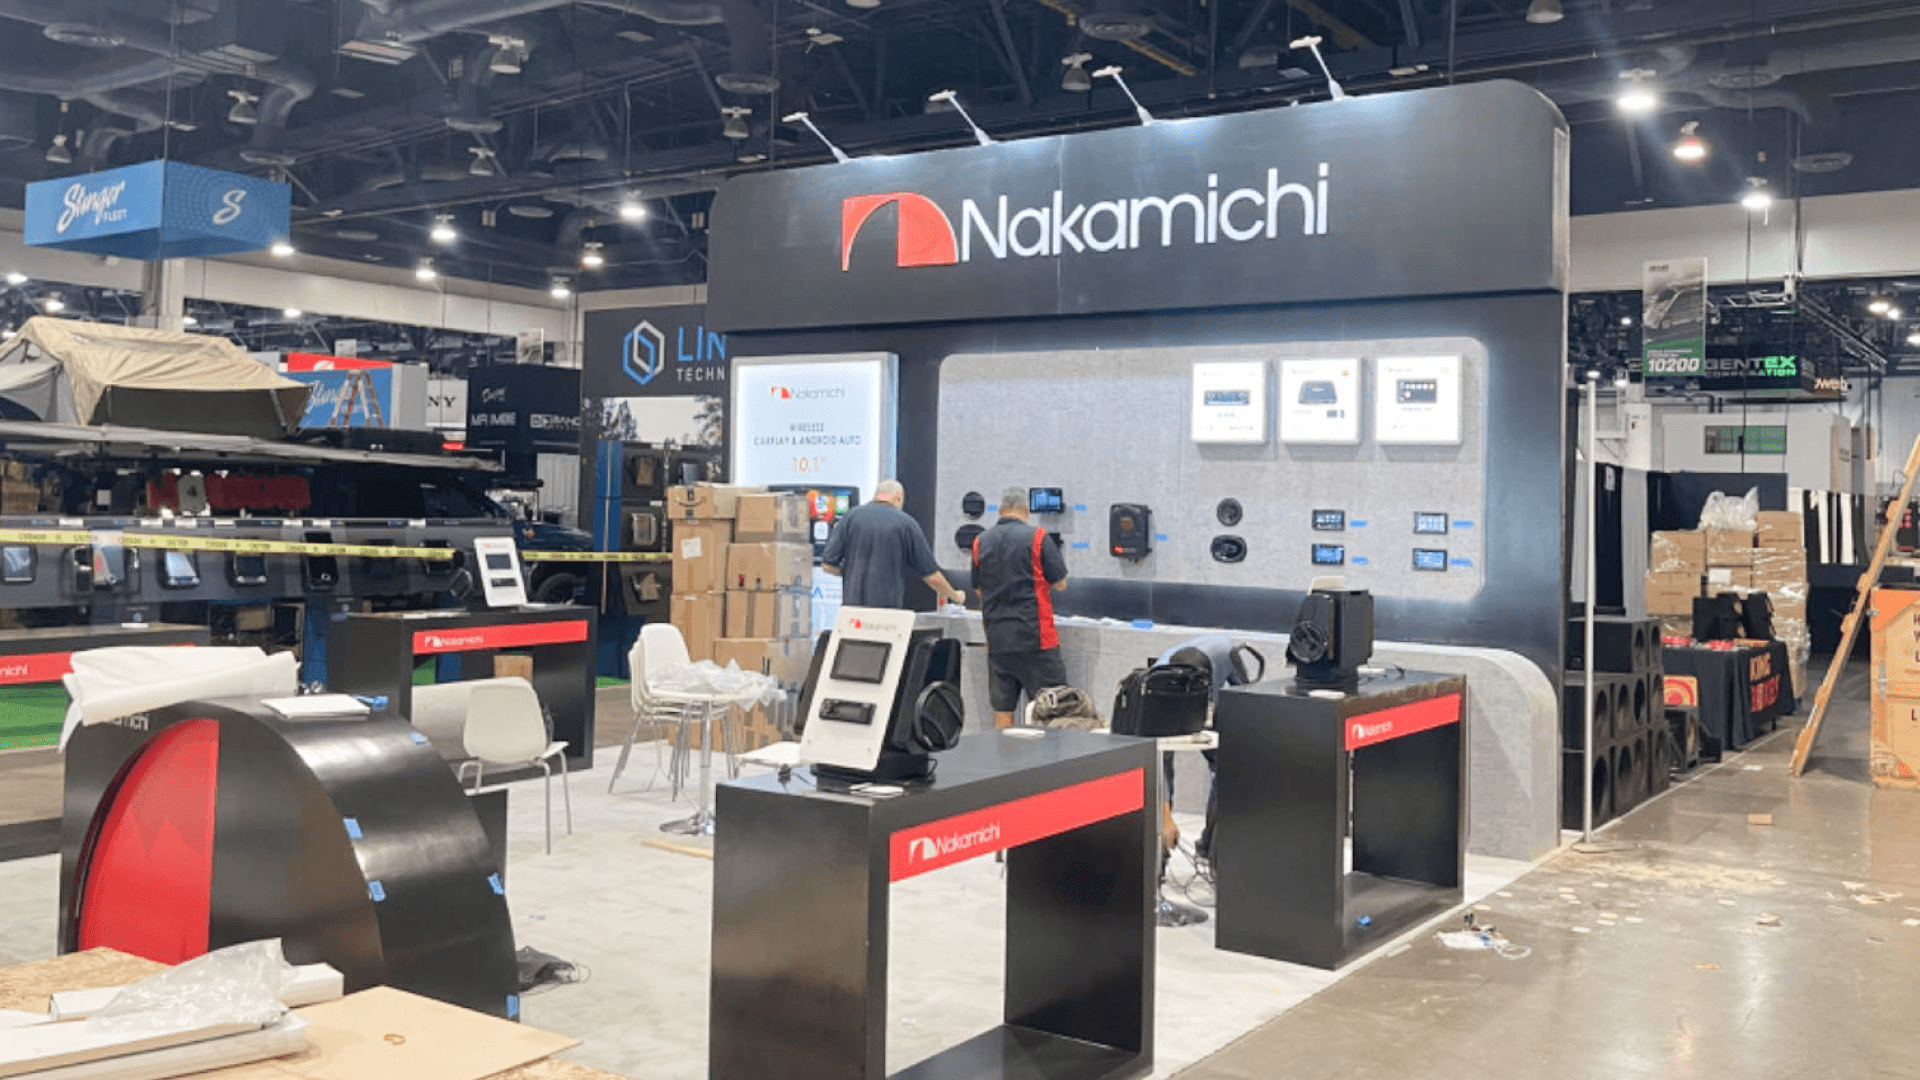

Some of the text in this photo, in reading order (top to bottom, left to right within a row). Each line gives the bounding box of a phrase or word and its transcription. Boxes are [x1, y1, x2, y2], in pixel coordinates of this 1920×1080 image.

[56, 180, 126, 234] Stinger
[961, 163, 1329, 263] Nakamichi
[676, 365, 726, 382] TECHN
[1648, 357, 1700, 373] 10200
[935, 820, 1001, 856] Nakamichi
